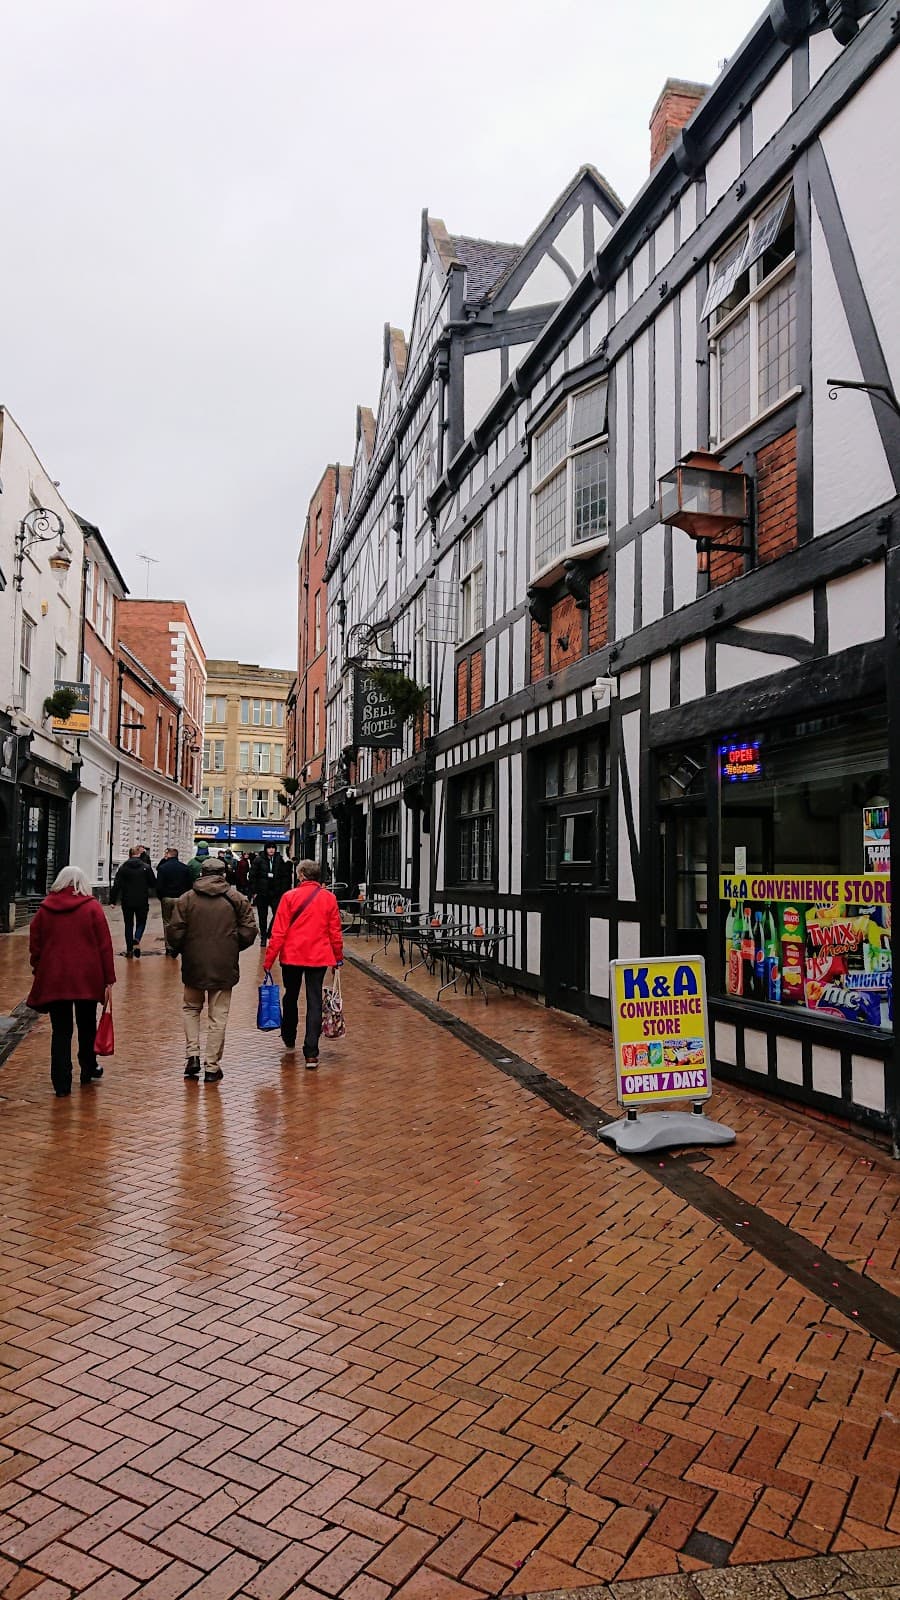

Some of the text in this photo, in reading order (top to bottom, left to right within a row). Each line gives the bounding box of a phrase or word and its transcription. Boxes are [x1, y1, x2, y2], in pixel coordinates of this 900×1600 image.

[361, 705, 396, 723] BELL
[360, 719, 397, 737] HOTEL
[729, 748, 753, 762] OPEN
[723, 879, 748, 899] K&A
[751, 880, 839, 902] CONVENIENCE
[806, 922, 856, 946] TWIX
[623, 965, 698, 999] K&A
[620, 998, 702, 1019] CONVENIENCE
[643, 1018, 681, 1036] STORE
[625, 1070, 705, 1094] OPEN 7 DAYS
